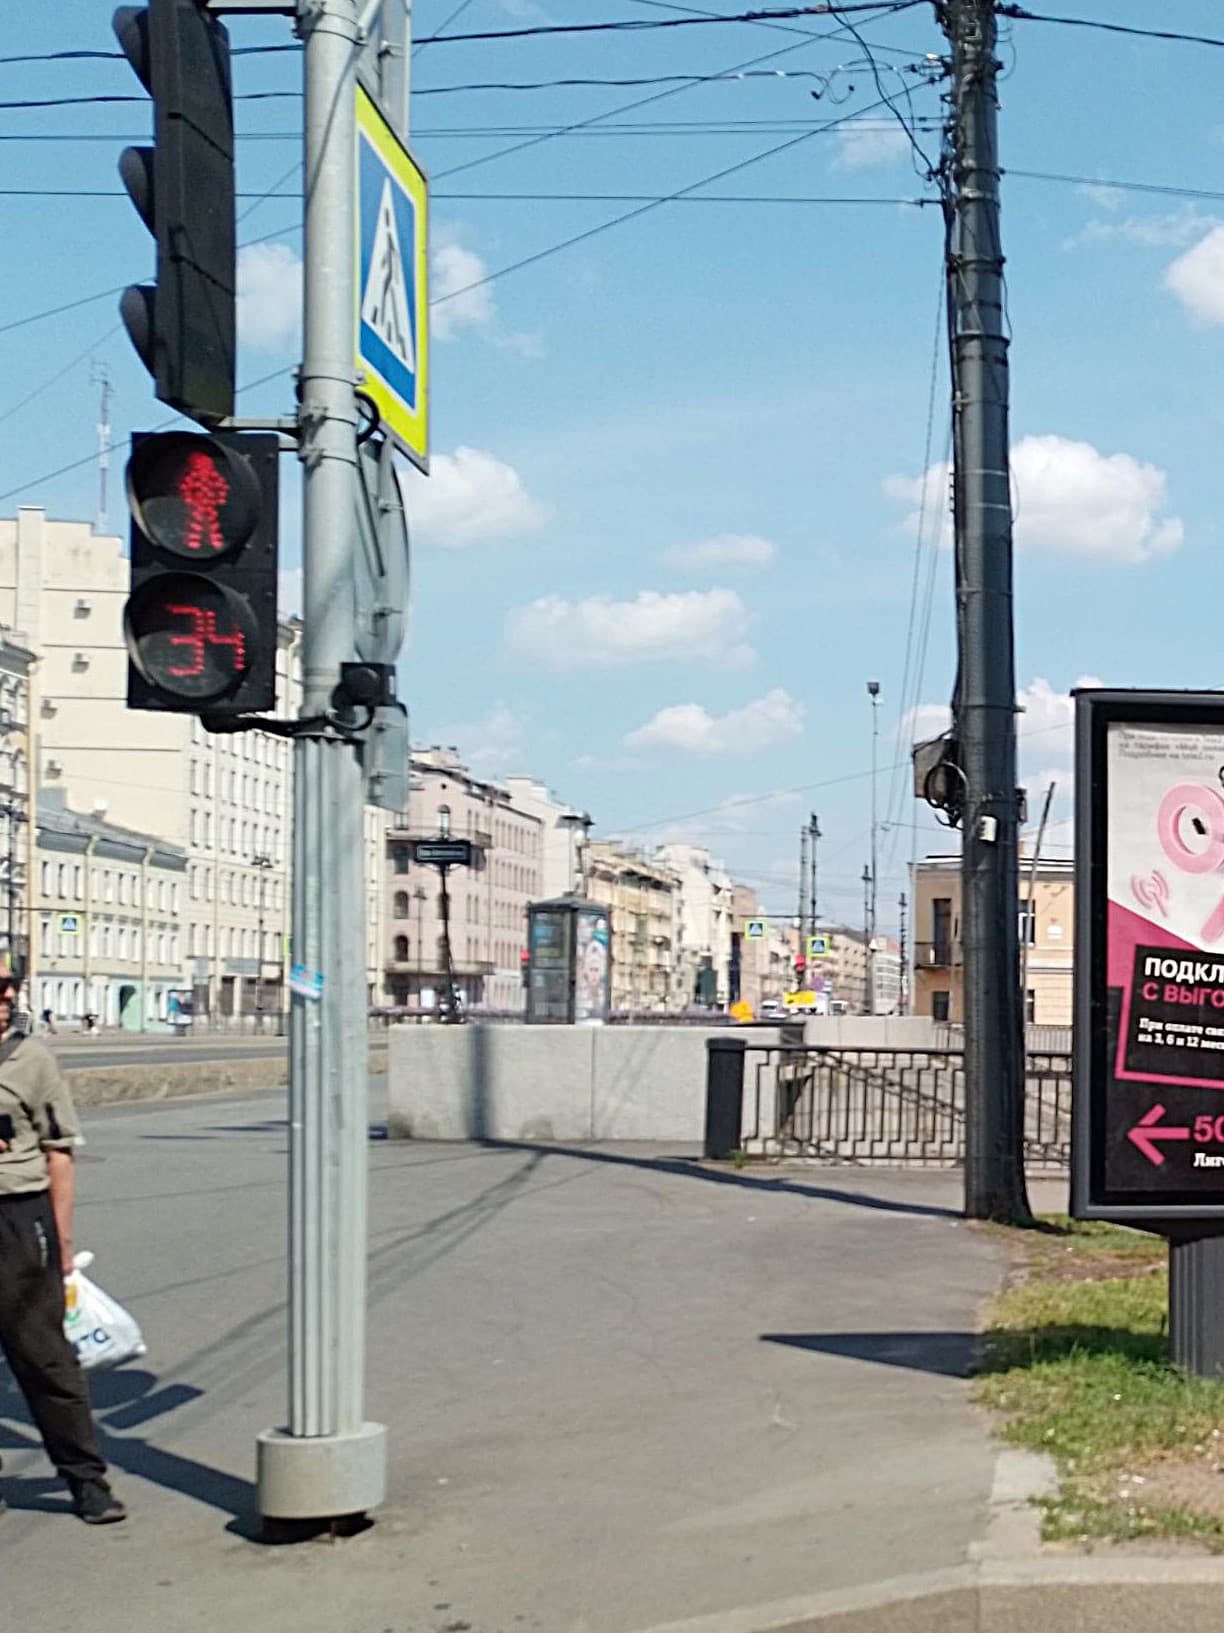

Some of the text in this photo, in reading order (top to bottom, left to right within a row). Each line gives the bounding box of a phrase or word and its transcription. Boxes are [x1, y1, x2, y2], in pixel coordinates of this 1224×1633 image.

[166, 604, 246, 677] 34
[1142, 982, 1159, 1001] С
[1186, 1035, 1200, 1048] 12
